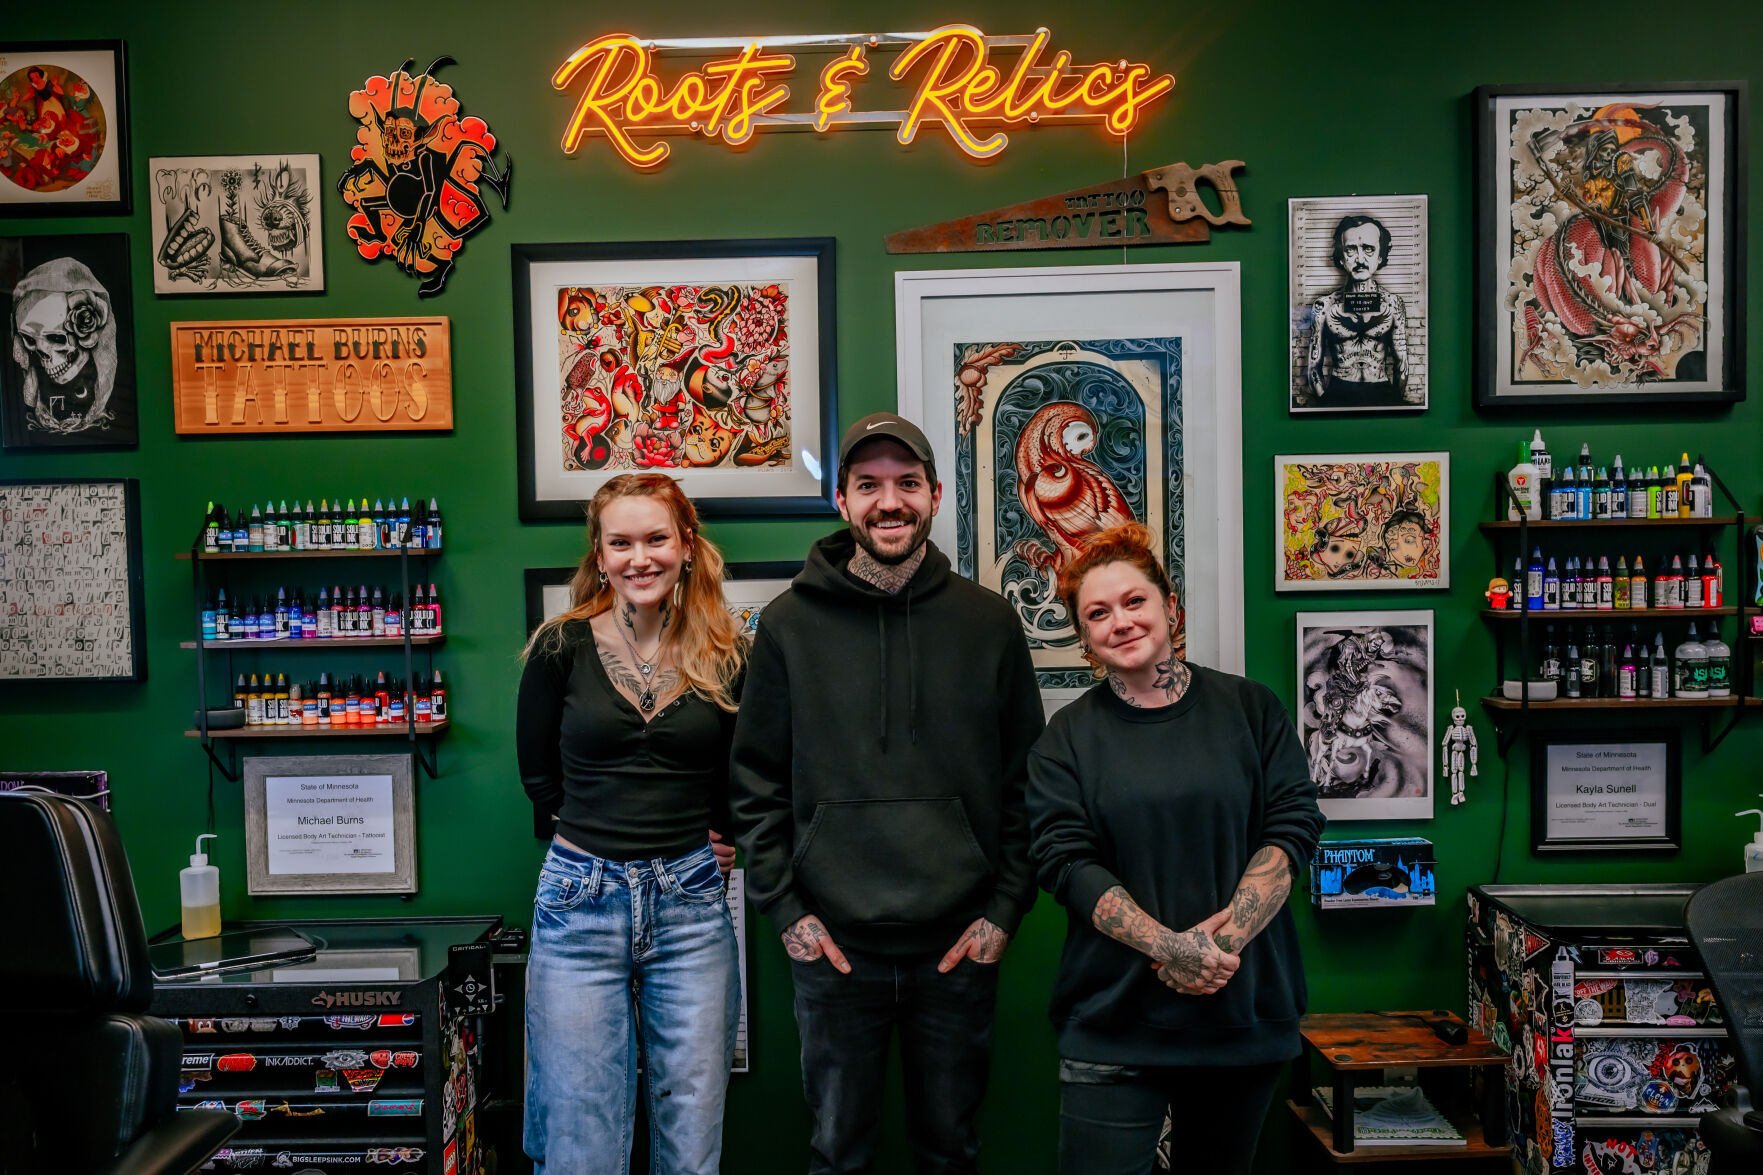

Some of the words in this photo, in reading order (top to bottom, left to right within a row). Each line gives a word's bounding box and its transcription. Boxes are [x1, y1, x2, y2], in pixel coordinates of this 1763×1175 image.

[553, 35, 795, 166] Roots
[815, 45, 869, 131] &
[889, 25, 1175, 158] Relics
[1064, 189, 1146, 210] TATTOO
[975, 207, 1152, 246] REMOVER
[194, 328, 324, 362] MICHAEL
[333, 326, 428, 360] BURNS
[194, 361, 429, 424] TATTOOS
[300, 783, 317, 791] State
[326, 782, 360, 790] Minnesota
[1576, 784, 1603, 796] Kayla
[1606, 784, 1637, 794] Sunell
[297, 816, 334, 825] Michael
[336, 816, 364, 825] Burns
[1324, 848, 1374, 864] PHANTOM
[336, 991, 401, 1006] HUSKY
[180, 1056, 209, 1066] reme
[372, 1100, 418, 1112] Diamond
[1606, 1138, 1638, 1159] NOT
